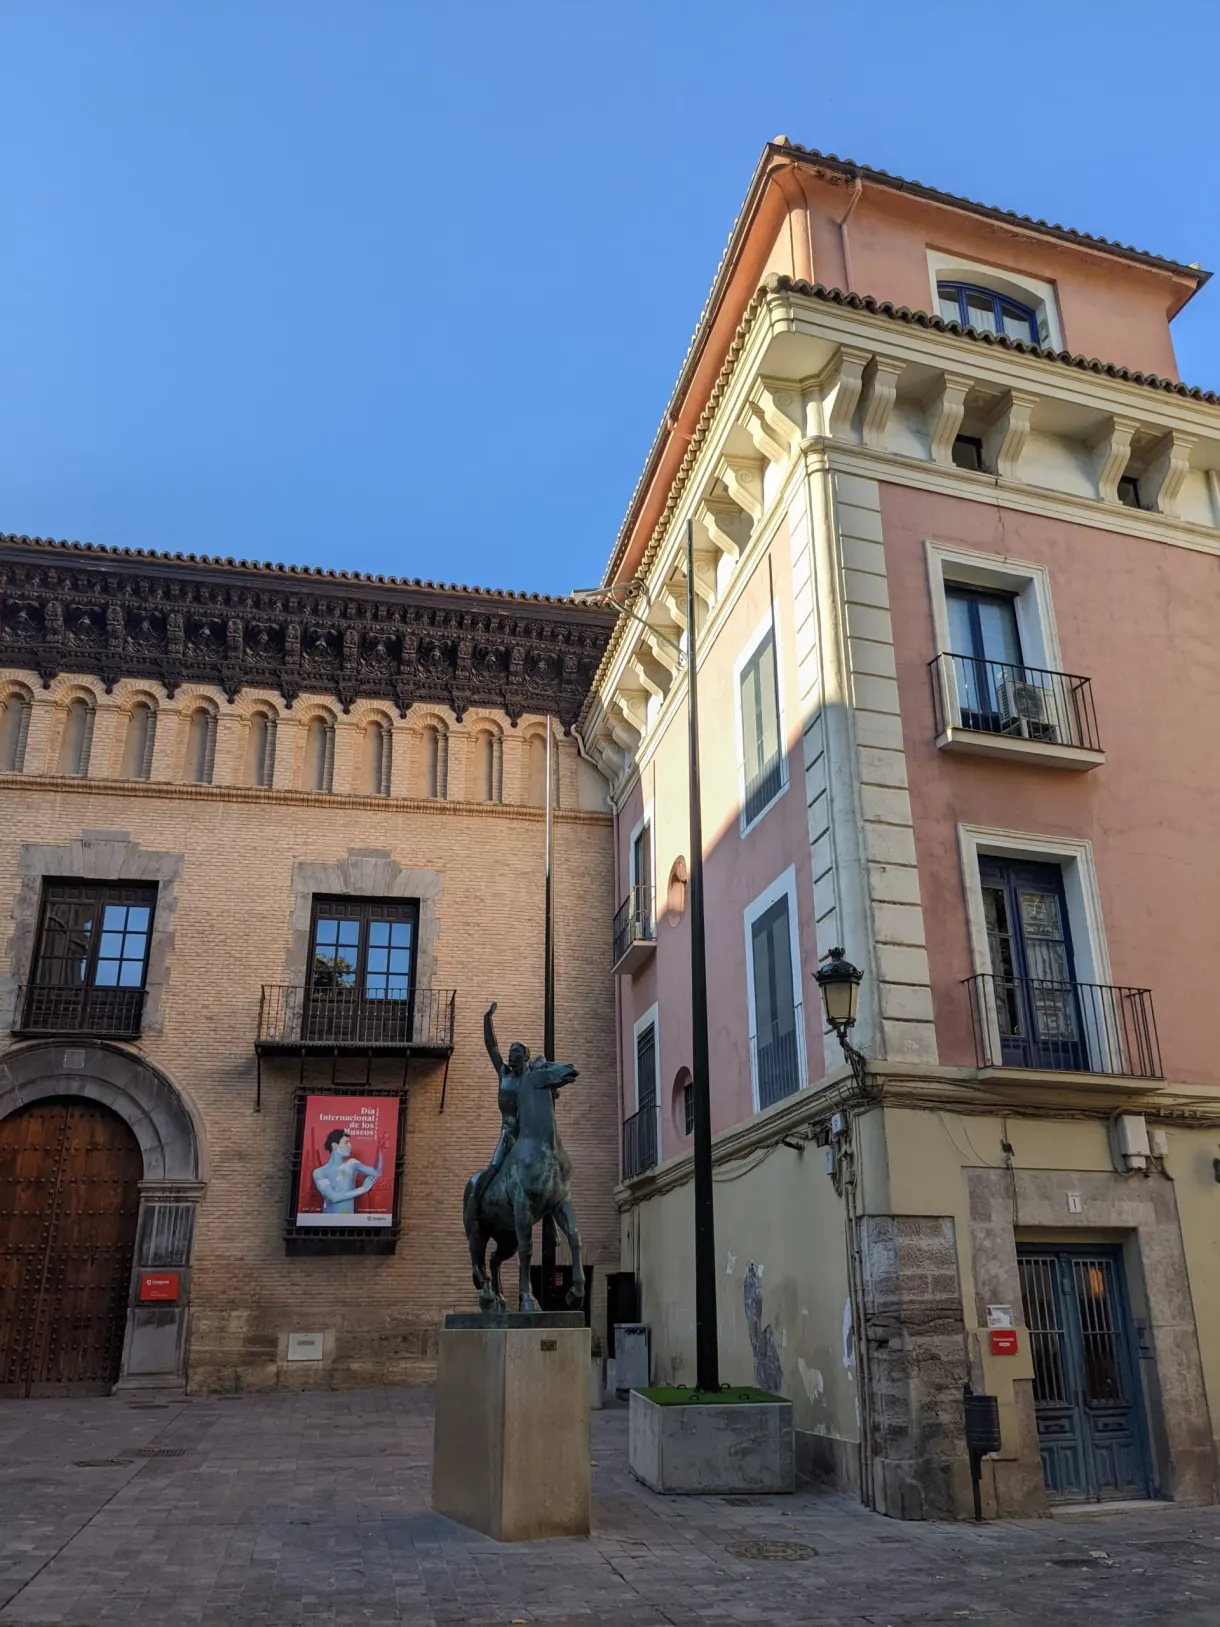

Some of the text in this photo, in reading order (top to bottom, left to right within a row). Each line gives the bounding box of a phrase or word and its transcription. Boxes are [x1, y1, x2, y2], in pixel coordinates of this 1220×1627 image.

[361, 1106, 375, 1115] Día
[319, 1113, 375, 1121] Internacional
[349, 1121, 374, 1129] de los
[343, 1128, 374, 1136] Museos
